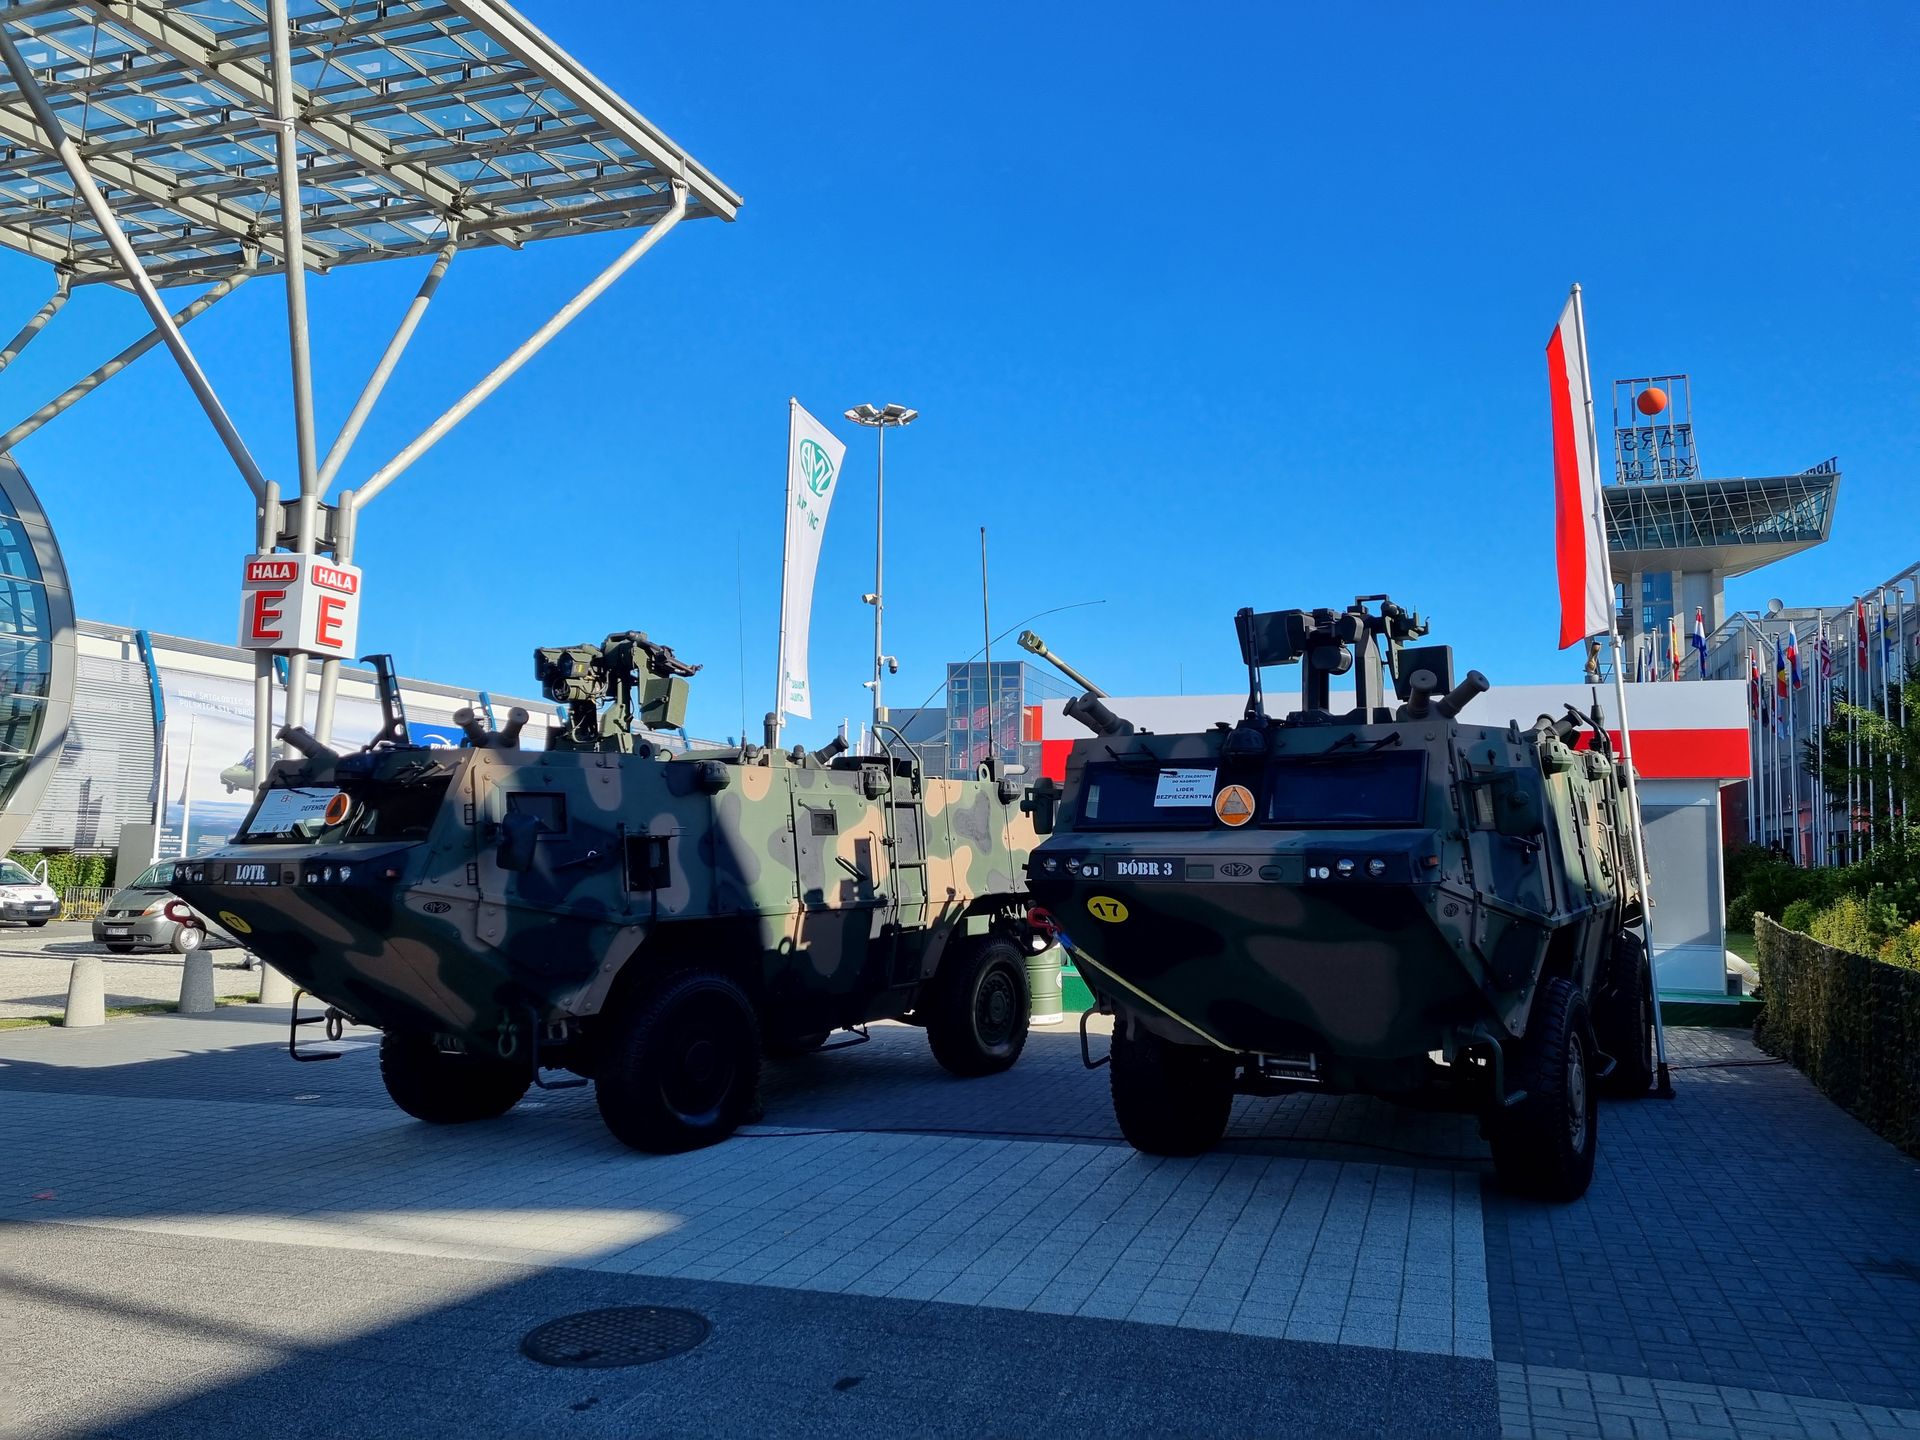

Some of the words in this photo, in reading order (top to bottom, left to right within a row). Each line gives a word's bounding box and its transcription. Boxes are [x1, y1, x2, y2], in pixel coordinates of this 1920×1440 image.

[252, 564, 291, 579] HALA
[318, 568, 353, 591] HALA
[251, 590, 286, 640] E
[316, 594, 346, 649] E
[301, 804, 327, 812] DEFENDE
[235, 864, 265, 880] LOTR
[1117, 859, 1160, 876] BÓBR
[1163, 862, 1173, 876] 3
[1092, 902, 1119, 917] 17
[224, 916, 246, 929] 17
